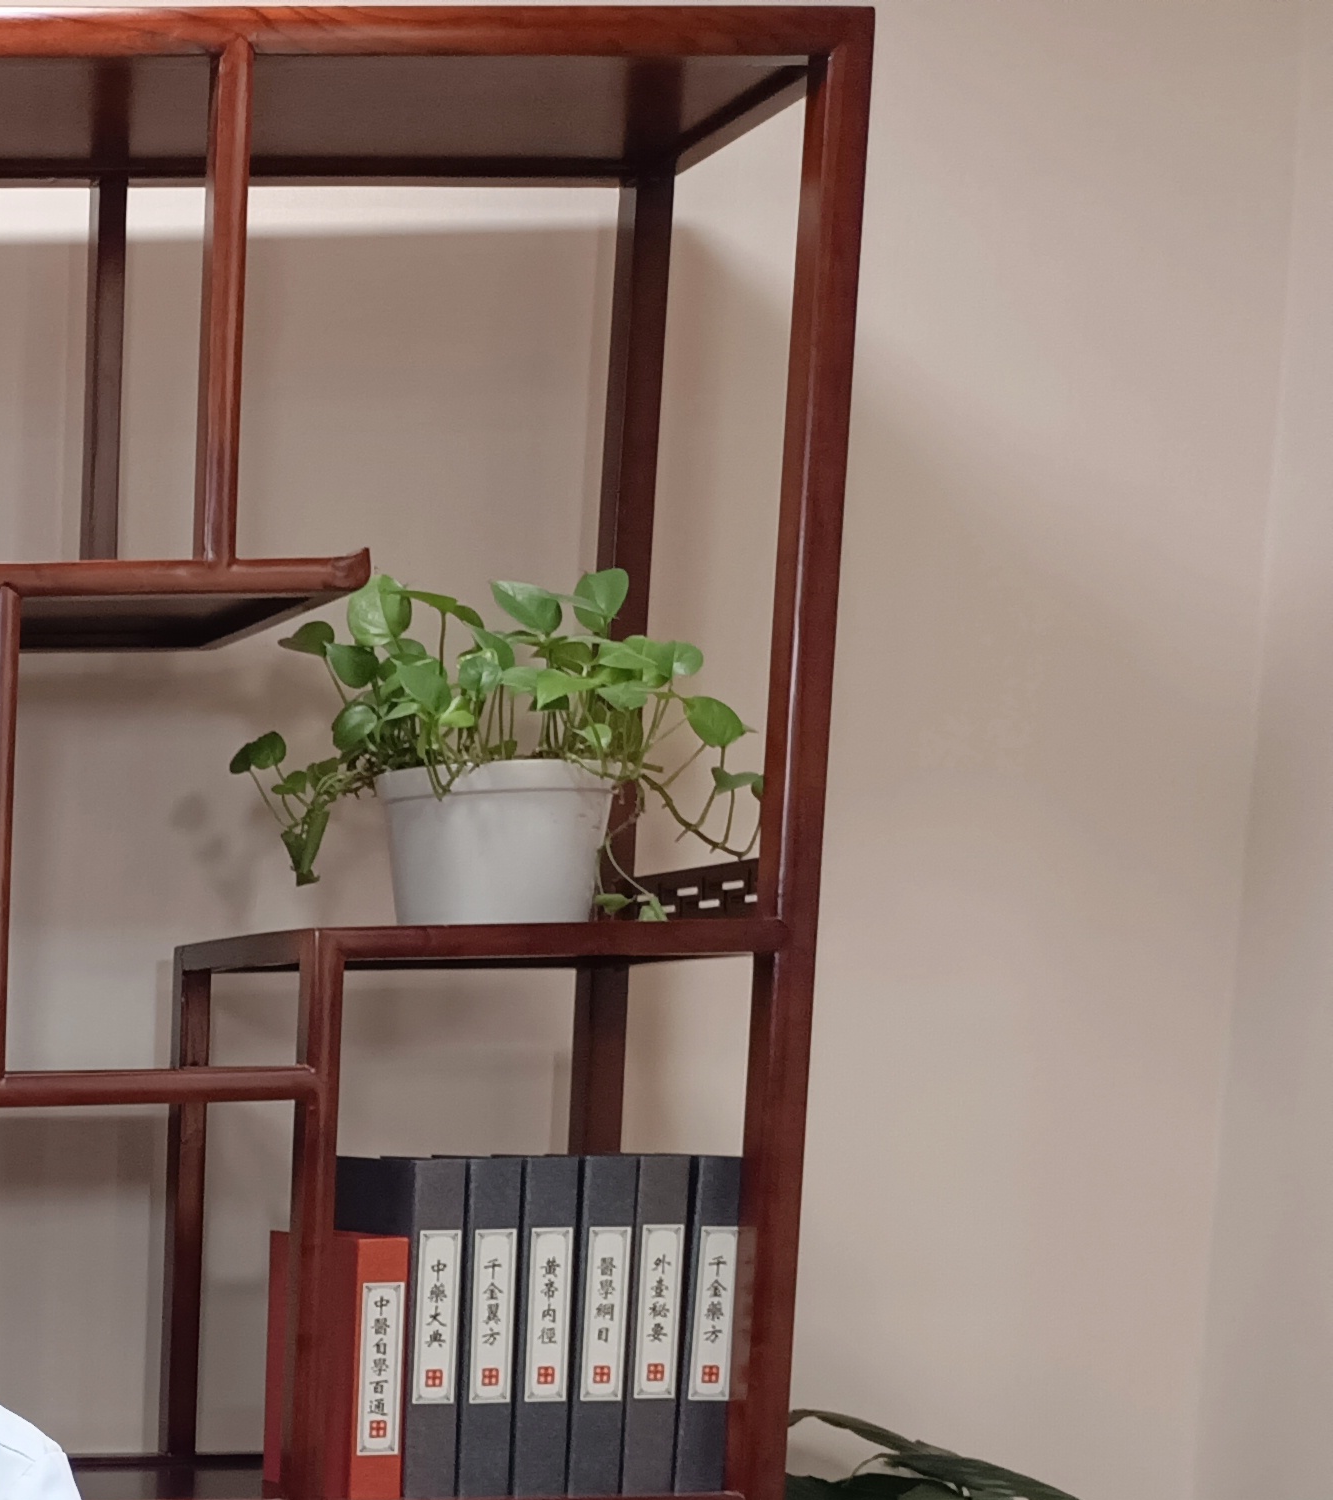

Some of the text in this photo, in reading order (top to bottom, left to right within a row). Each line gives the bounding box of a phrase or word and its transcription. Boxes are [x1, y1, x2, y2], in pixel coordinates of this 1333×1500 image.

[425, 1259, 448, 1348] 中藥大典
[481, 1258, 504, 1346] 千金翼方
[703, 1255, 728, 1344] 千金藥方
[367, 1295, 391, 1417] 中醫自學百通
